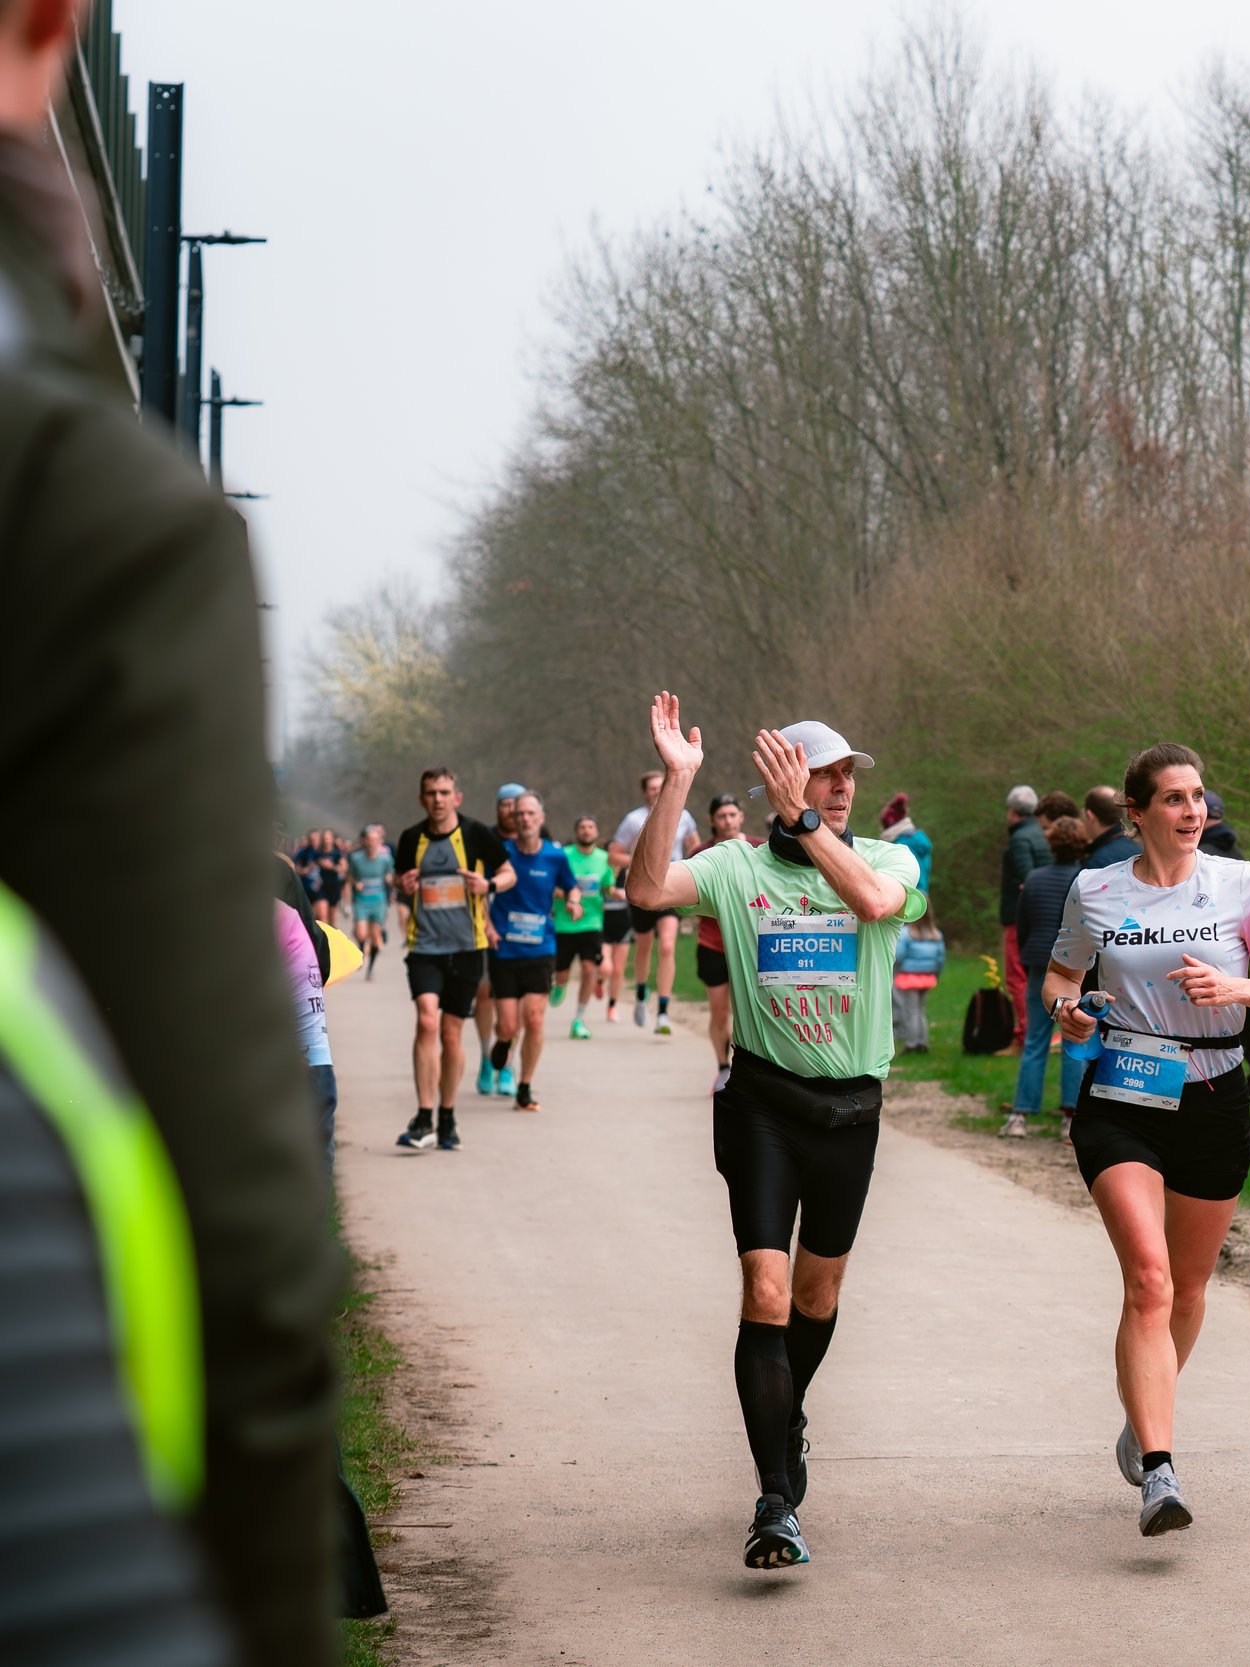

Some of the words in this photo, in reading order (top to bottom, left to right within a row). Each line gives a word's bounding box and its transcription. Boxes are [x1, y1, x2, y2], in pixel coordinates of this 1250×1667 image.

[826, 919, 845, 928] 21K
[1102, 923, 1220, 948] PeakLevel
[770, 938, 843, 953] JEROEN
[798, 959, 814, 968] 911
[770, 995, 850, 1018] BERLIN
[793, 1022, 833, 1044] 2025
[1159, 1044, 1178, 1055] 21K
[1115, 1055, 1161, 1077] KIRSI
[1122, 1077, 1145, 1089] 2998
